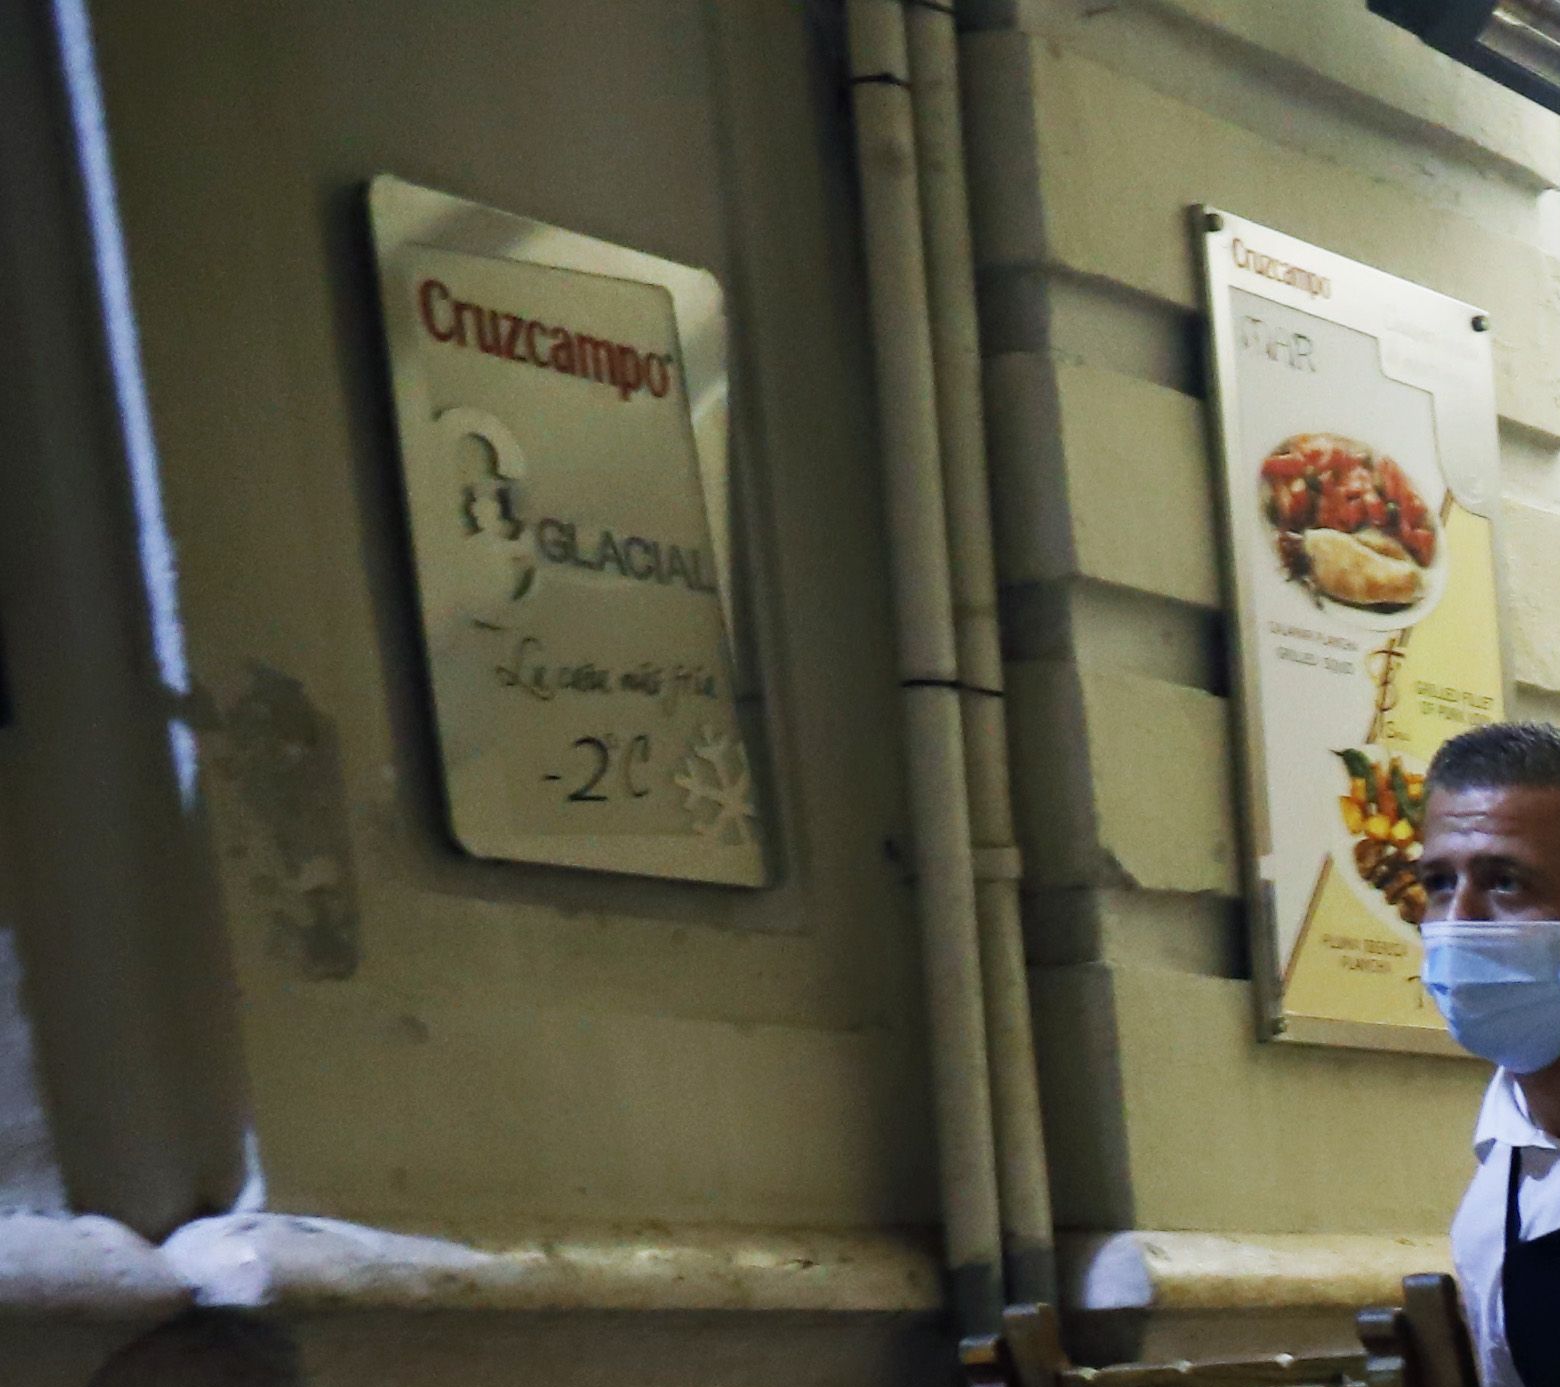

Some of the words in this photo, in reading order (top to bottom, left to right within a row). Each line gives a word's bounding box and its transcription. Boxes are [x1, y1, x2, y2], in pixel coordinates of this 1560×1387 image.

[1231, 237, 1332, 300] Cruzcampo
[418, 278, 670, 401] Cruzcampo
[534, 517, 722, 594] GLACIAL
